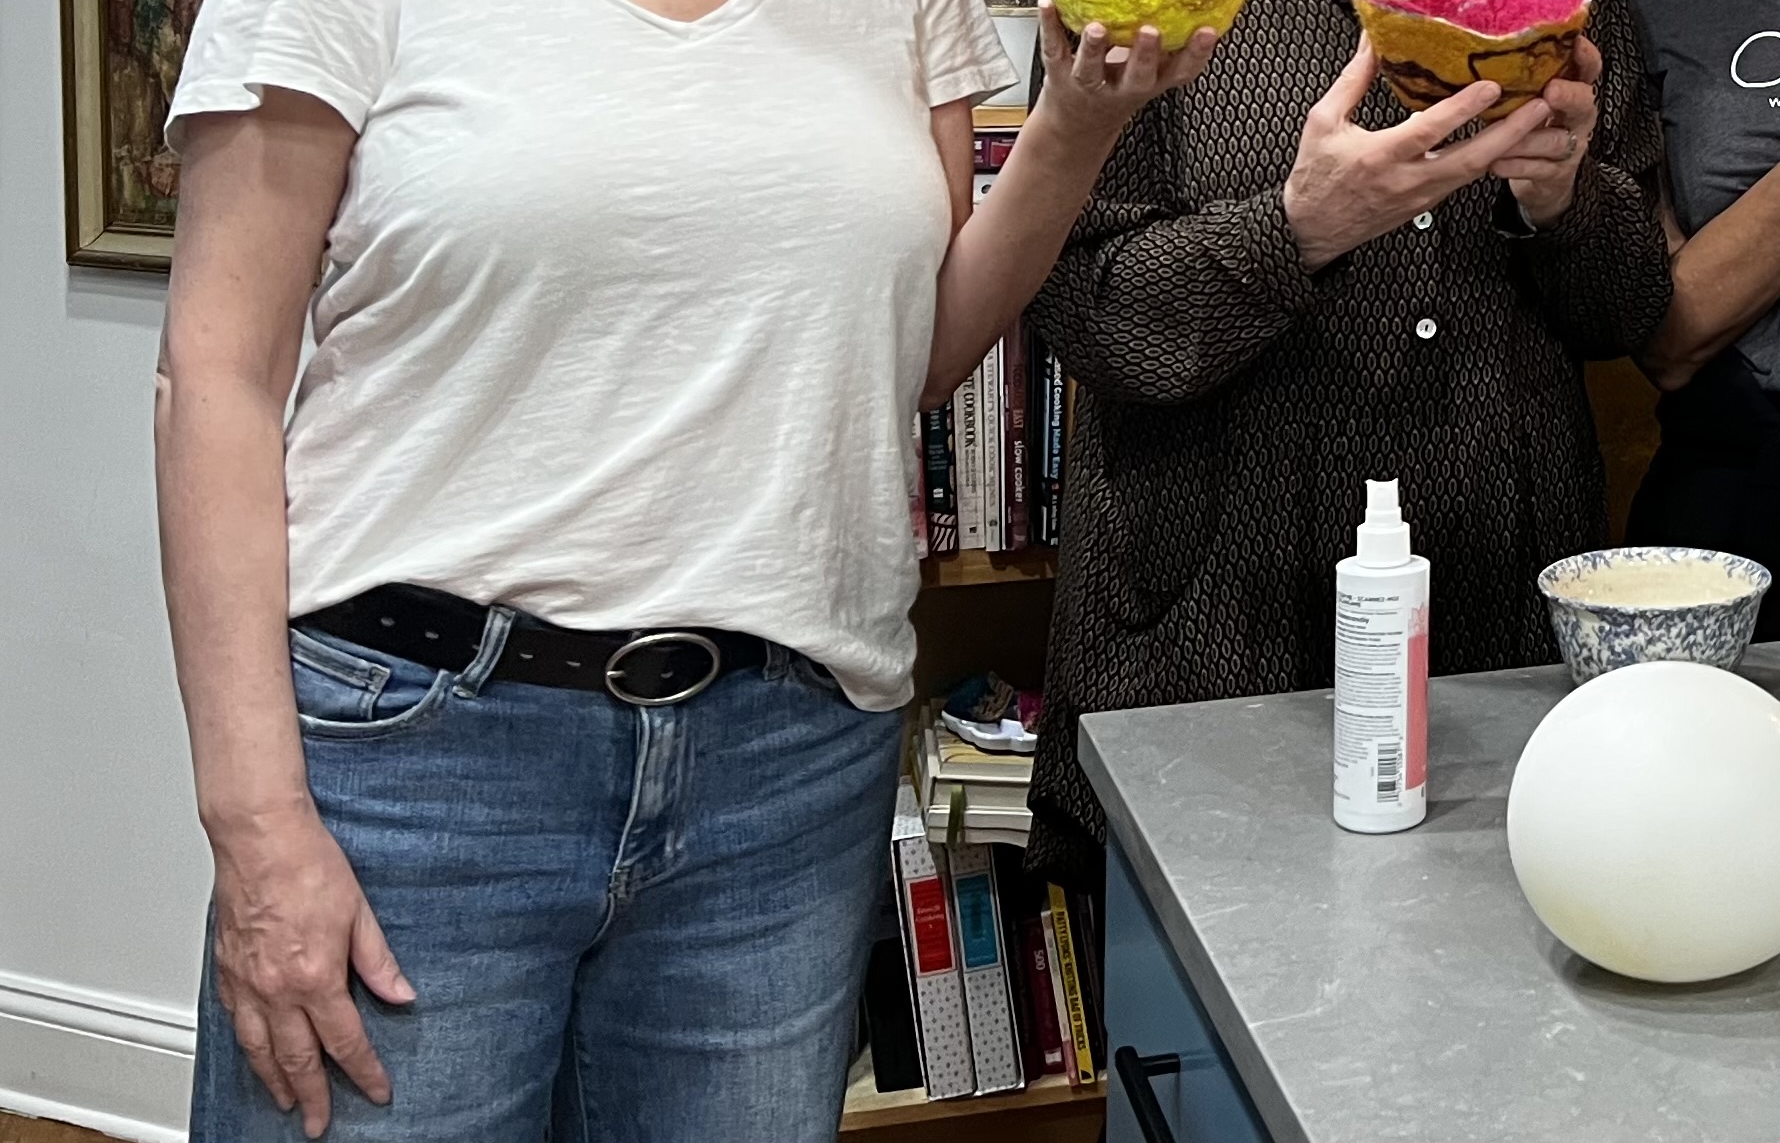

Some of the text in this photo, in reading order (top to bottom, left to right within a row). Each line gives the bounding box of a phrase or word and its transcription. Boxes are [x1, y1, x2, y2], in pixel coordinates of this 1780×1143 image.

[963, 392, 976, 448] COOKBOOK
[1051, 387, 1062, 427] Cooking
[1052, 428, 1062, 455] Made
[1014, 441, 1025, 503] slow cooker
[1050, 456, 1061, 480] Easy
[1034, 949, 1046, 970] 500
